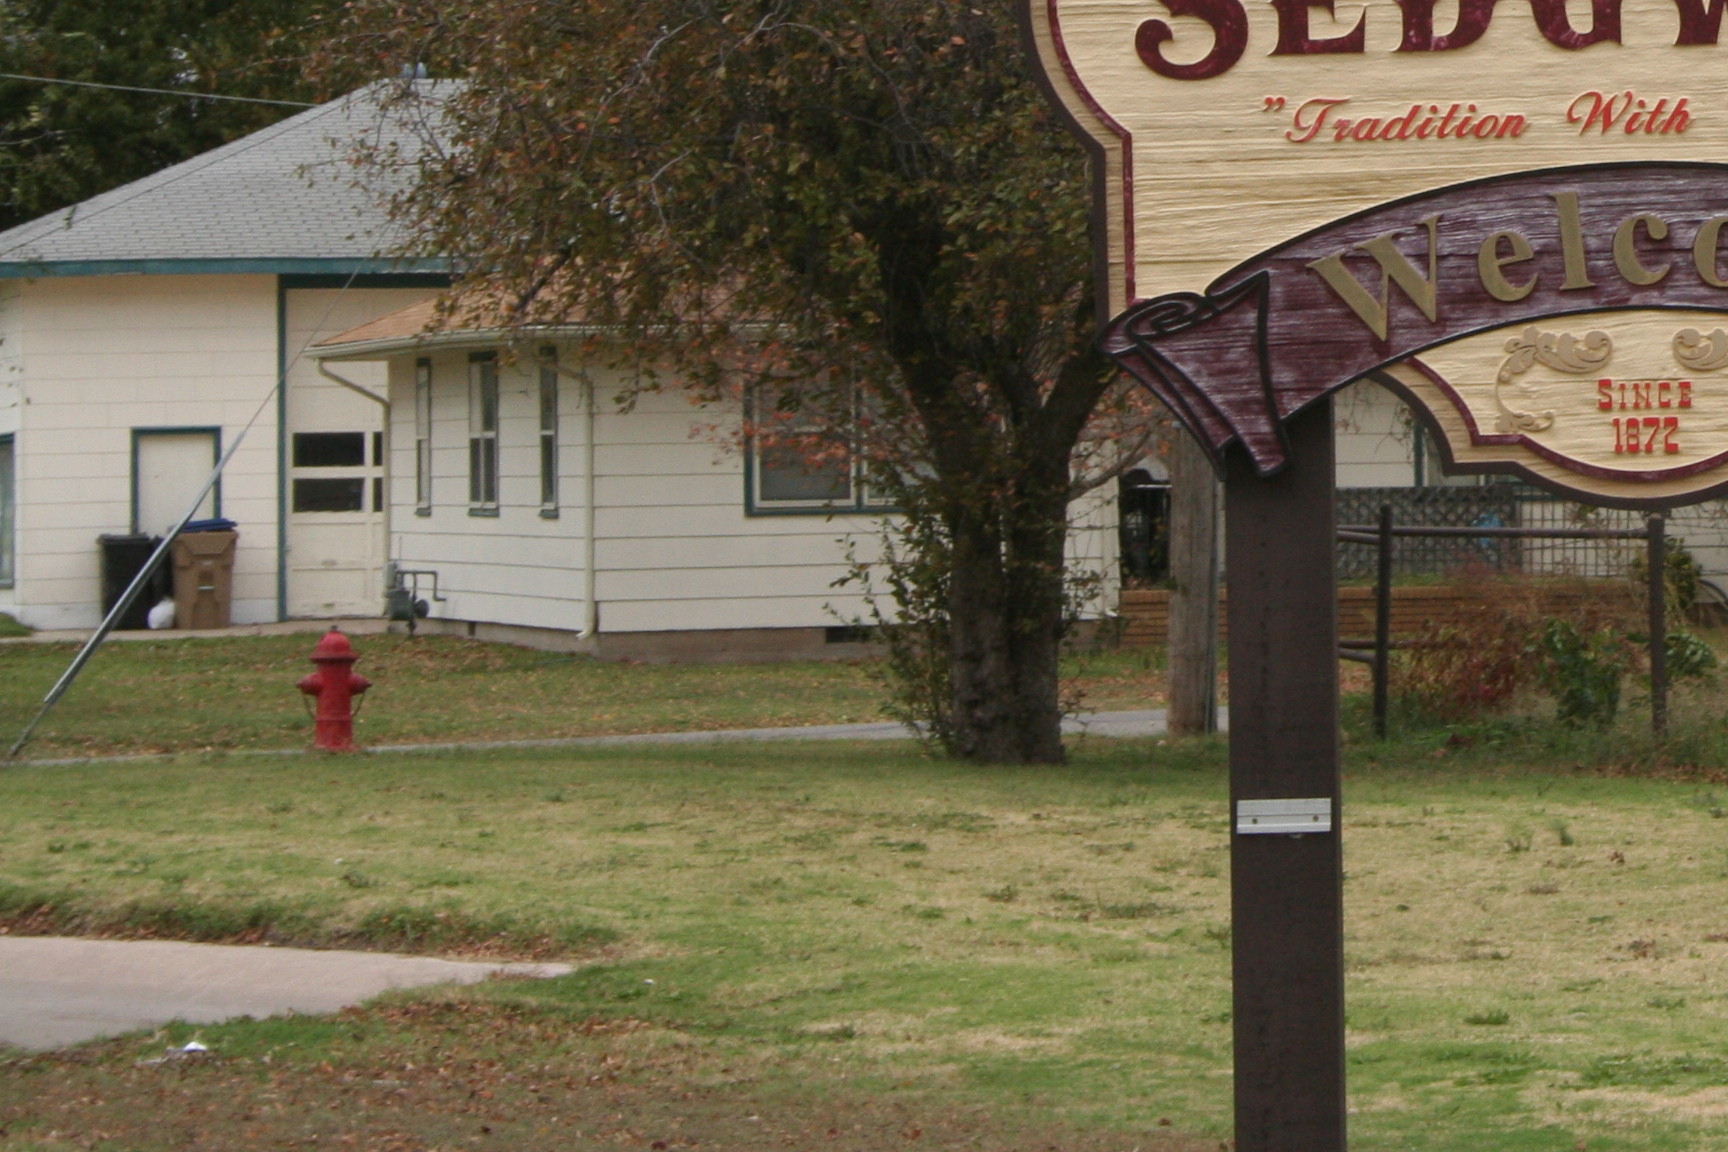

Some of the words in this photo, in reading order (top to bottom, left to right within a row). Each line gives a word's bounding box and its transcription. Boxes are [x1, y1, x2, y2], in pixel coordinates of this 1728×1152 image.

[1565, 90, 1694, 137] With
[1597, 378, 1693, 411] SINCE
[1611, 416, 1680, 455] 1872
